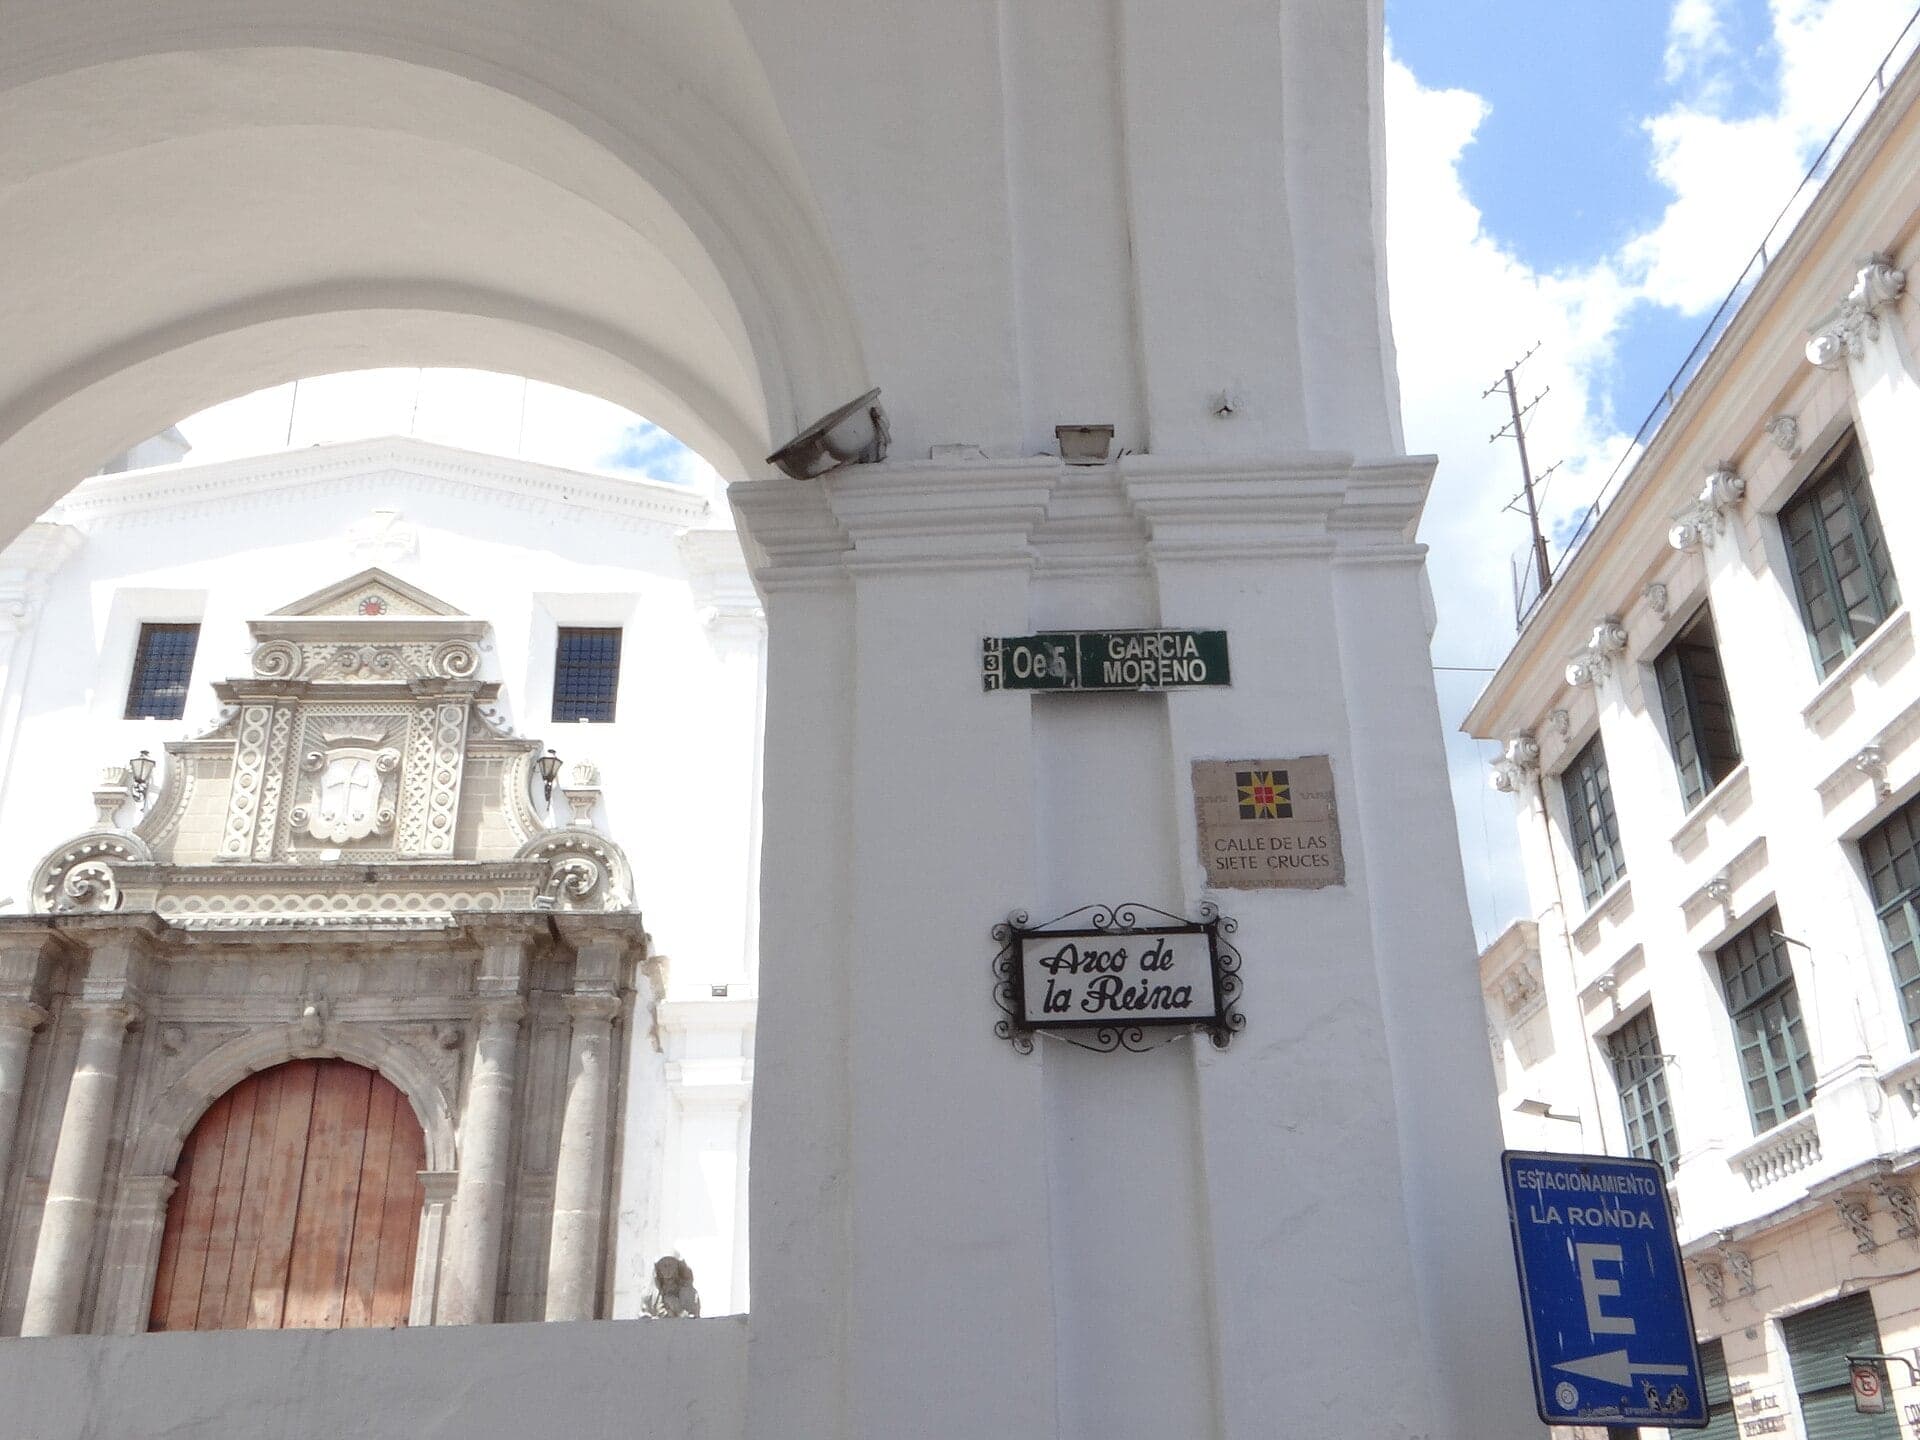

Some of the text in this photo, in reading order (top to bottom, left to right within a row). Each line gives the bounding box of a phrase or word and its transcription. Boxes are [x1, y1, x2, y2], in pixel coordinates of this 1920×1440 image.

[1108, 634, 1199, 659] GARCIA
[1103, 658, 1207, 684] MORENO
[1214, 835, 1327, 852] CALLE DE LAS
[1216, 854, 1330, 870] SIETE CRUCES
[1039, 938, 1175, 975] Arco de
[1043, 974, 1193, 1013] la Reina
[1517, 1169, 1657, 1196] ESTACIONAMIENTO
[1530, 1205, 1655, 1230] LA RONDA
[1576, 1242, 1637, 1336] E
